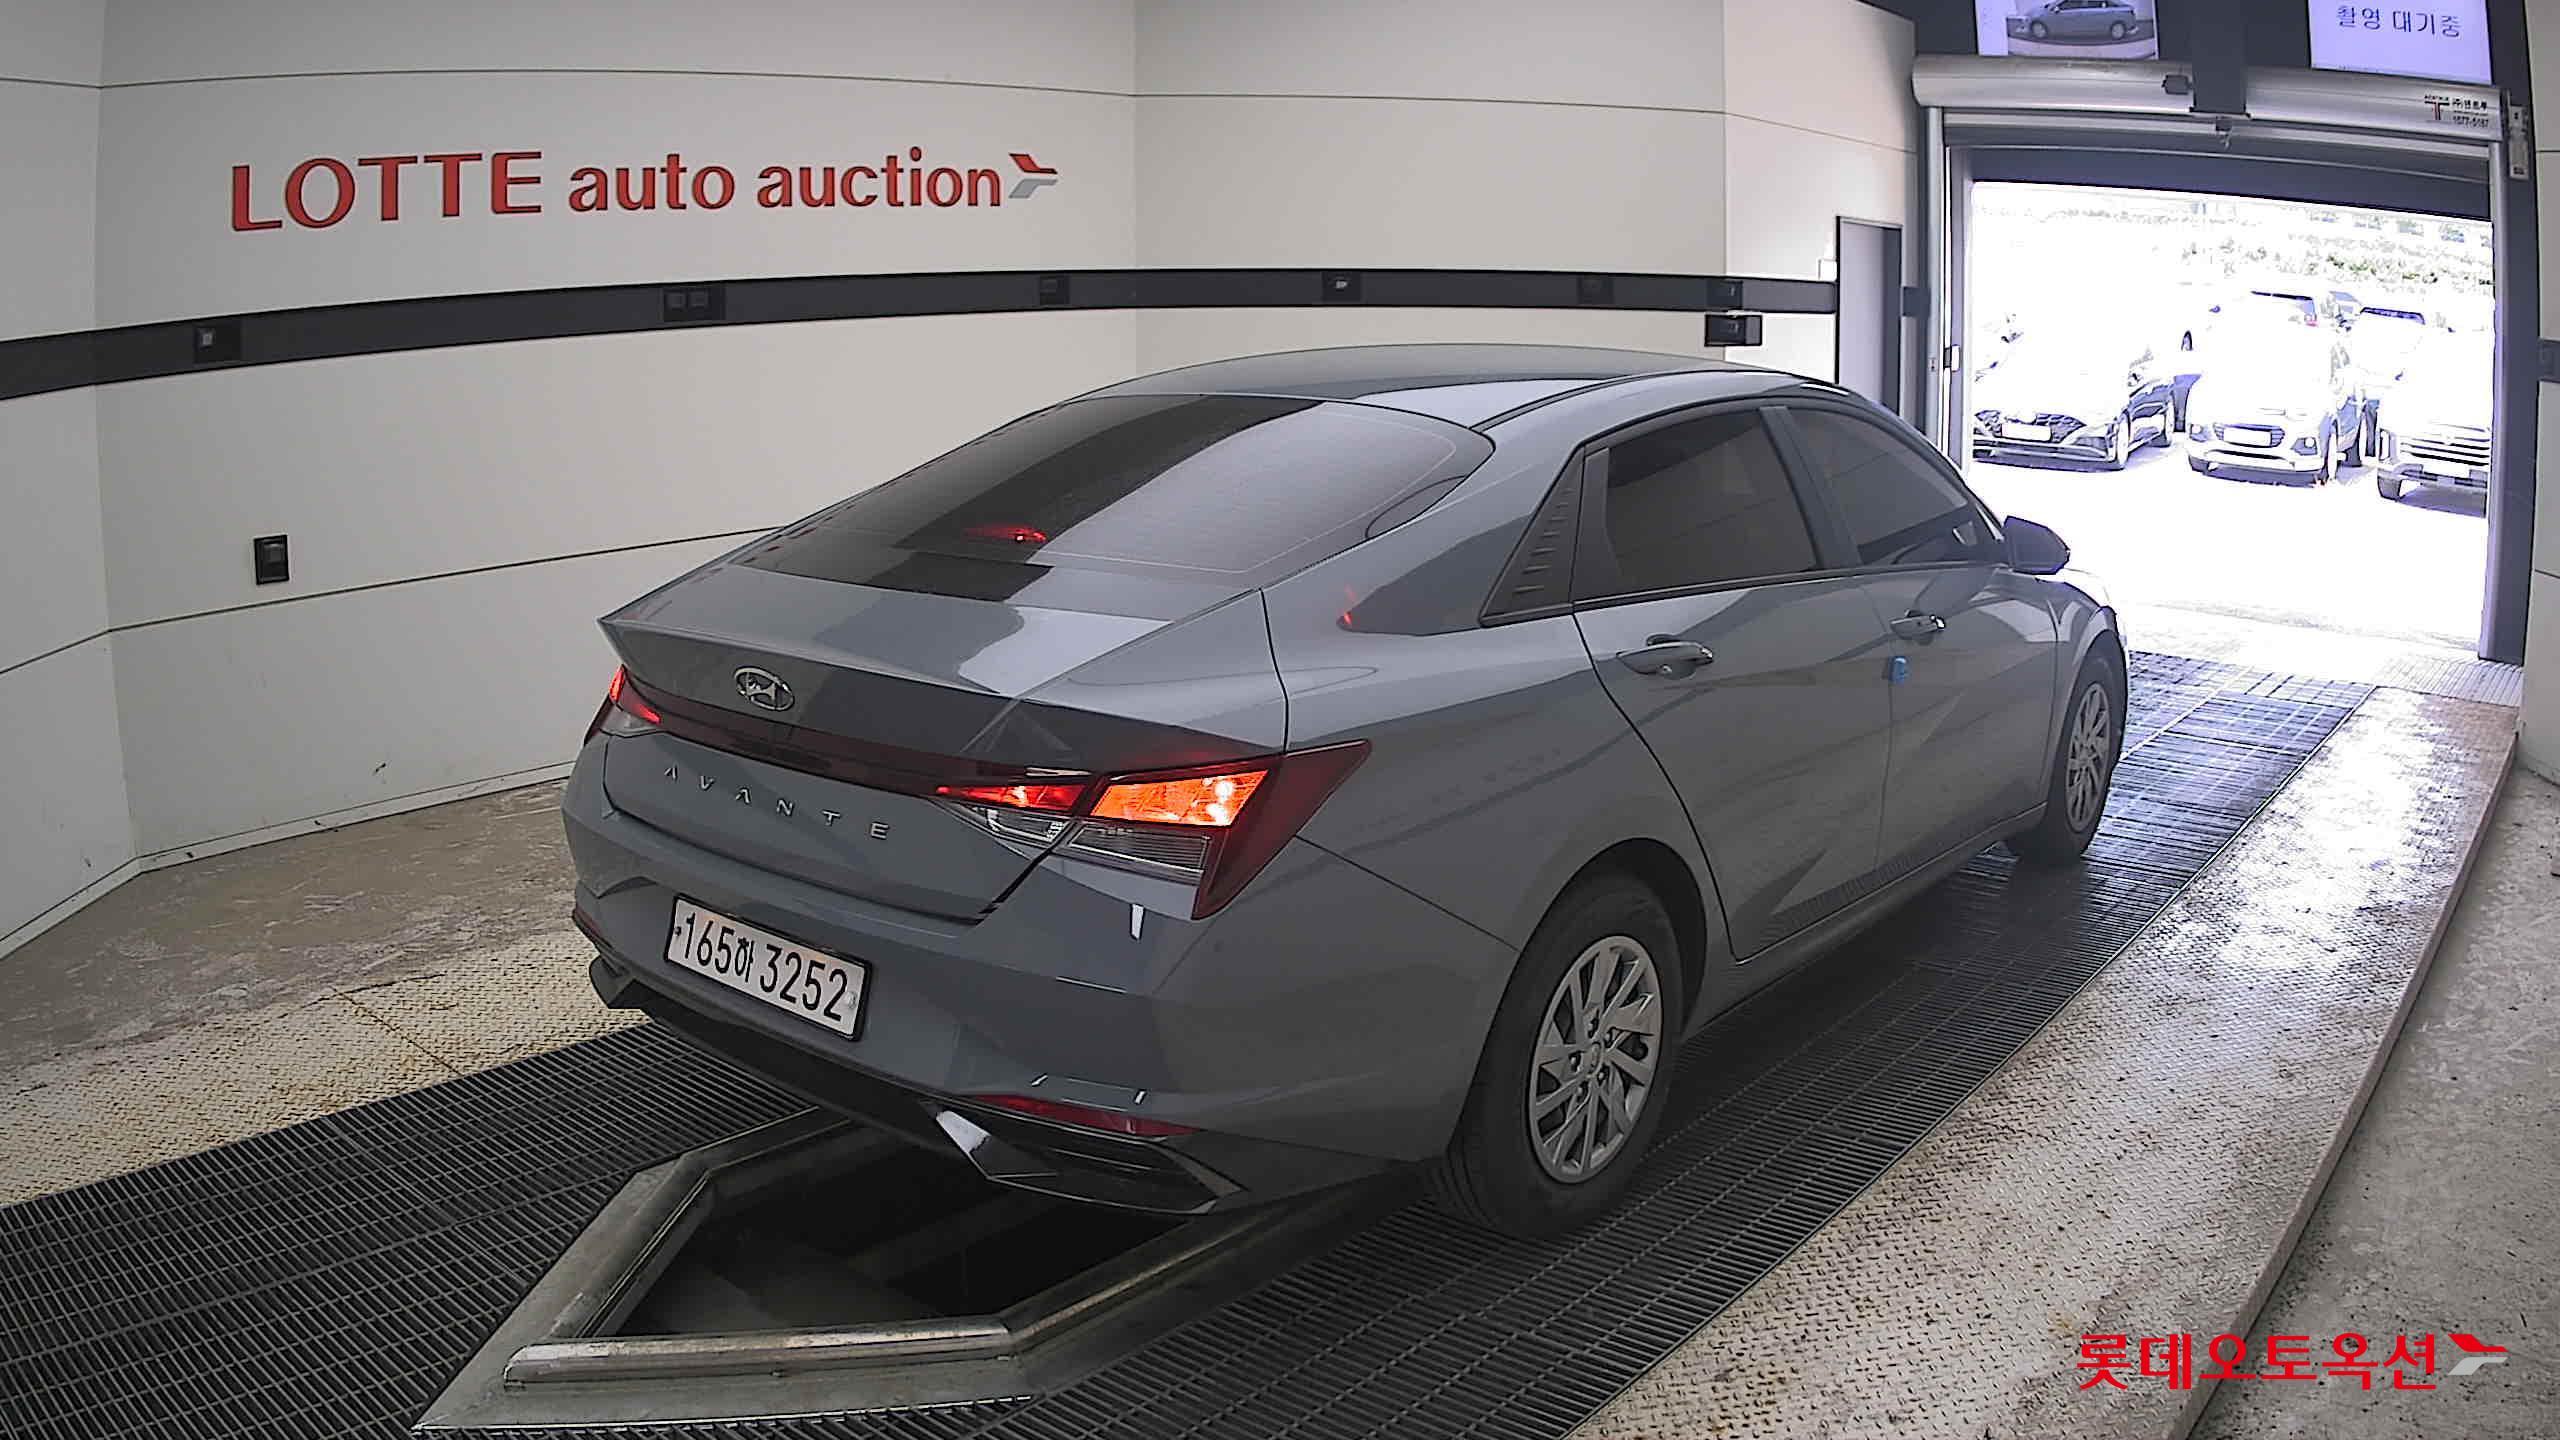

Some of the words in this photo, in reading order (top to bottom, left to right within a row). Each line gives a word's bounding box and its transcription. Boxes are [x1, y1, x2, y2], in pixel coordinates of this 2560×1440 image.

[2338, 5, 2382, 31] 촬영
[2392, 10, 2462, 38] 대기중
[232, 151, 543, 232] LOTTE
[568, 153, 736, 211] auto
[757, 146, 1002, 208] auction
[664, 764, 890, 840] AVANTE
[684, 911, 756, 983] 165하
[759, 943, 849, 1022] 3252
